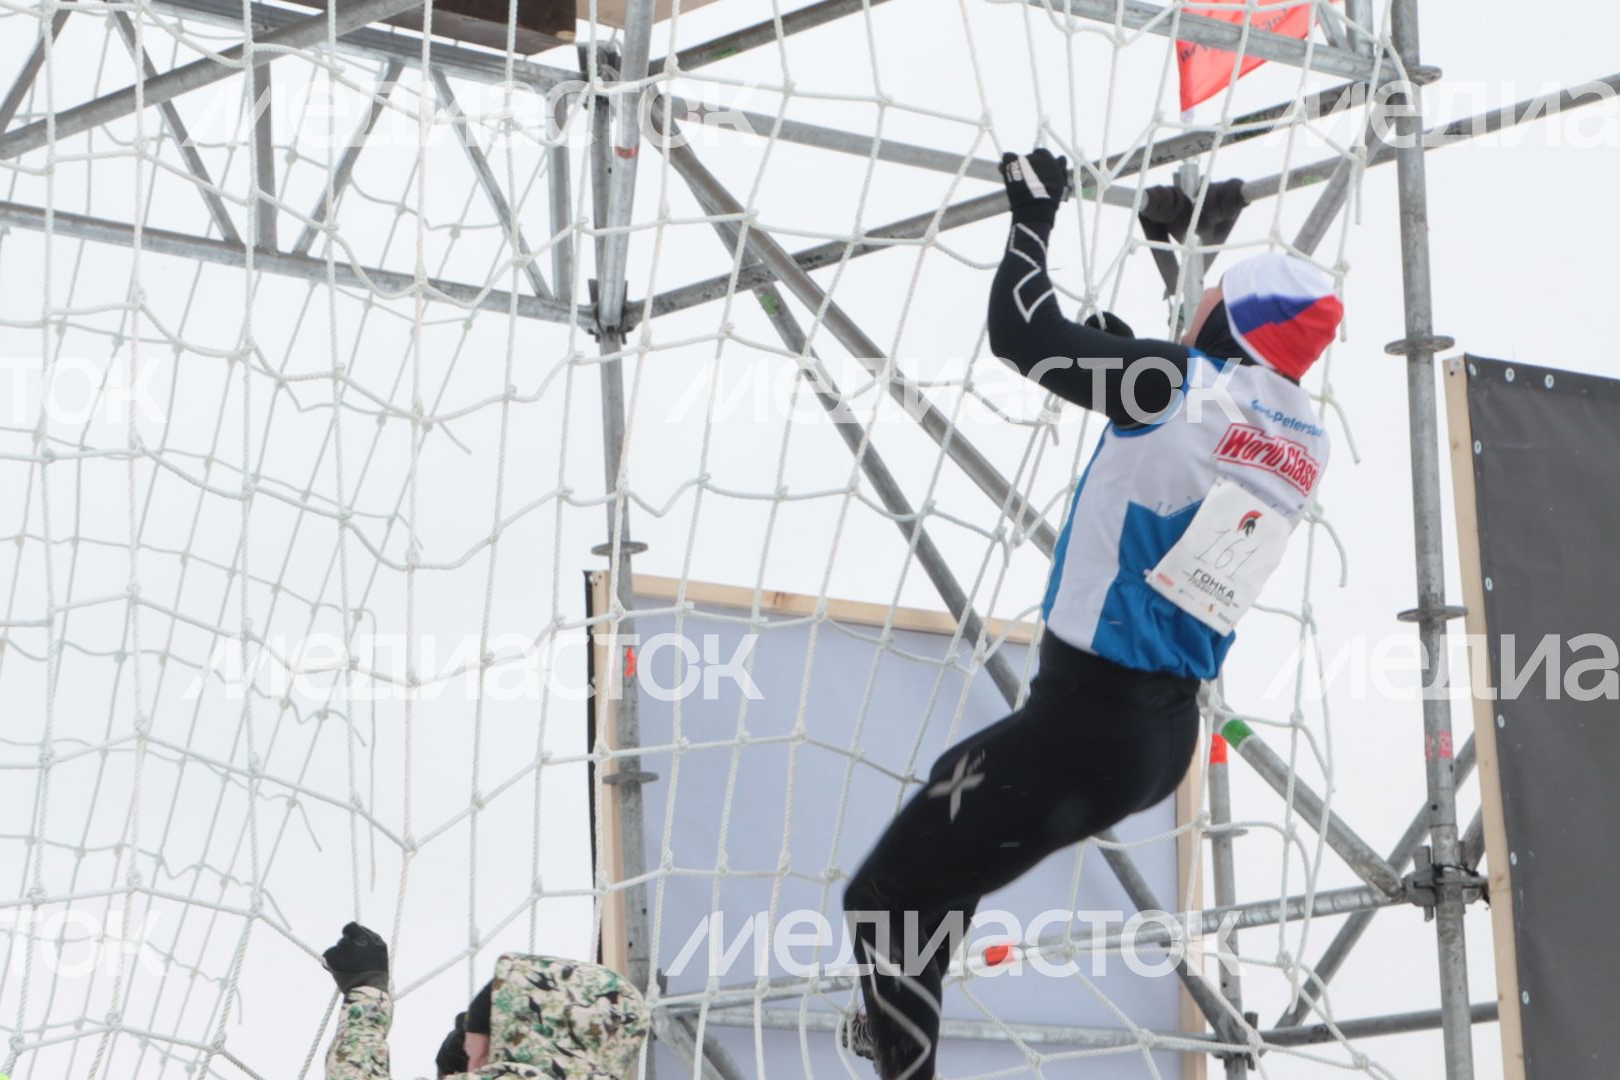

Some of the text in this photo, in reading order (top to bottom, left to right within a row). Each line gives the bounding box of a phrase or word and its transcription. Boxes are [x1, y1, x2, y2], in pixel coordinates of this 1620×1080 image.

[1221, 429, 1318, 492] World Class
[1193, 568, 1235, 600] ГОНКА
